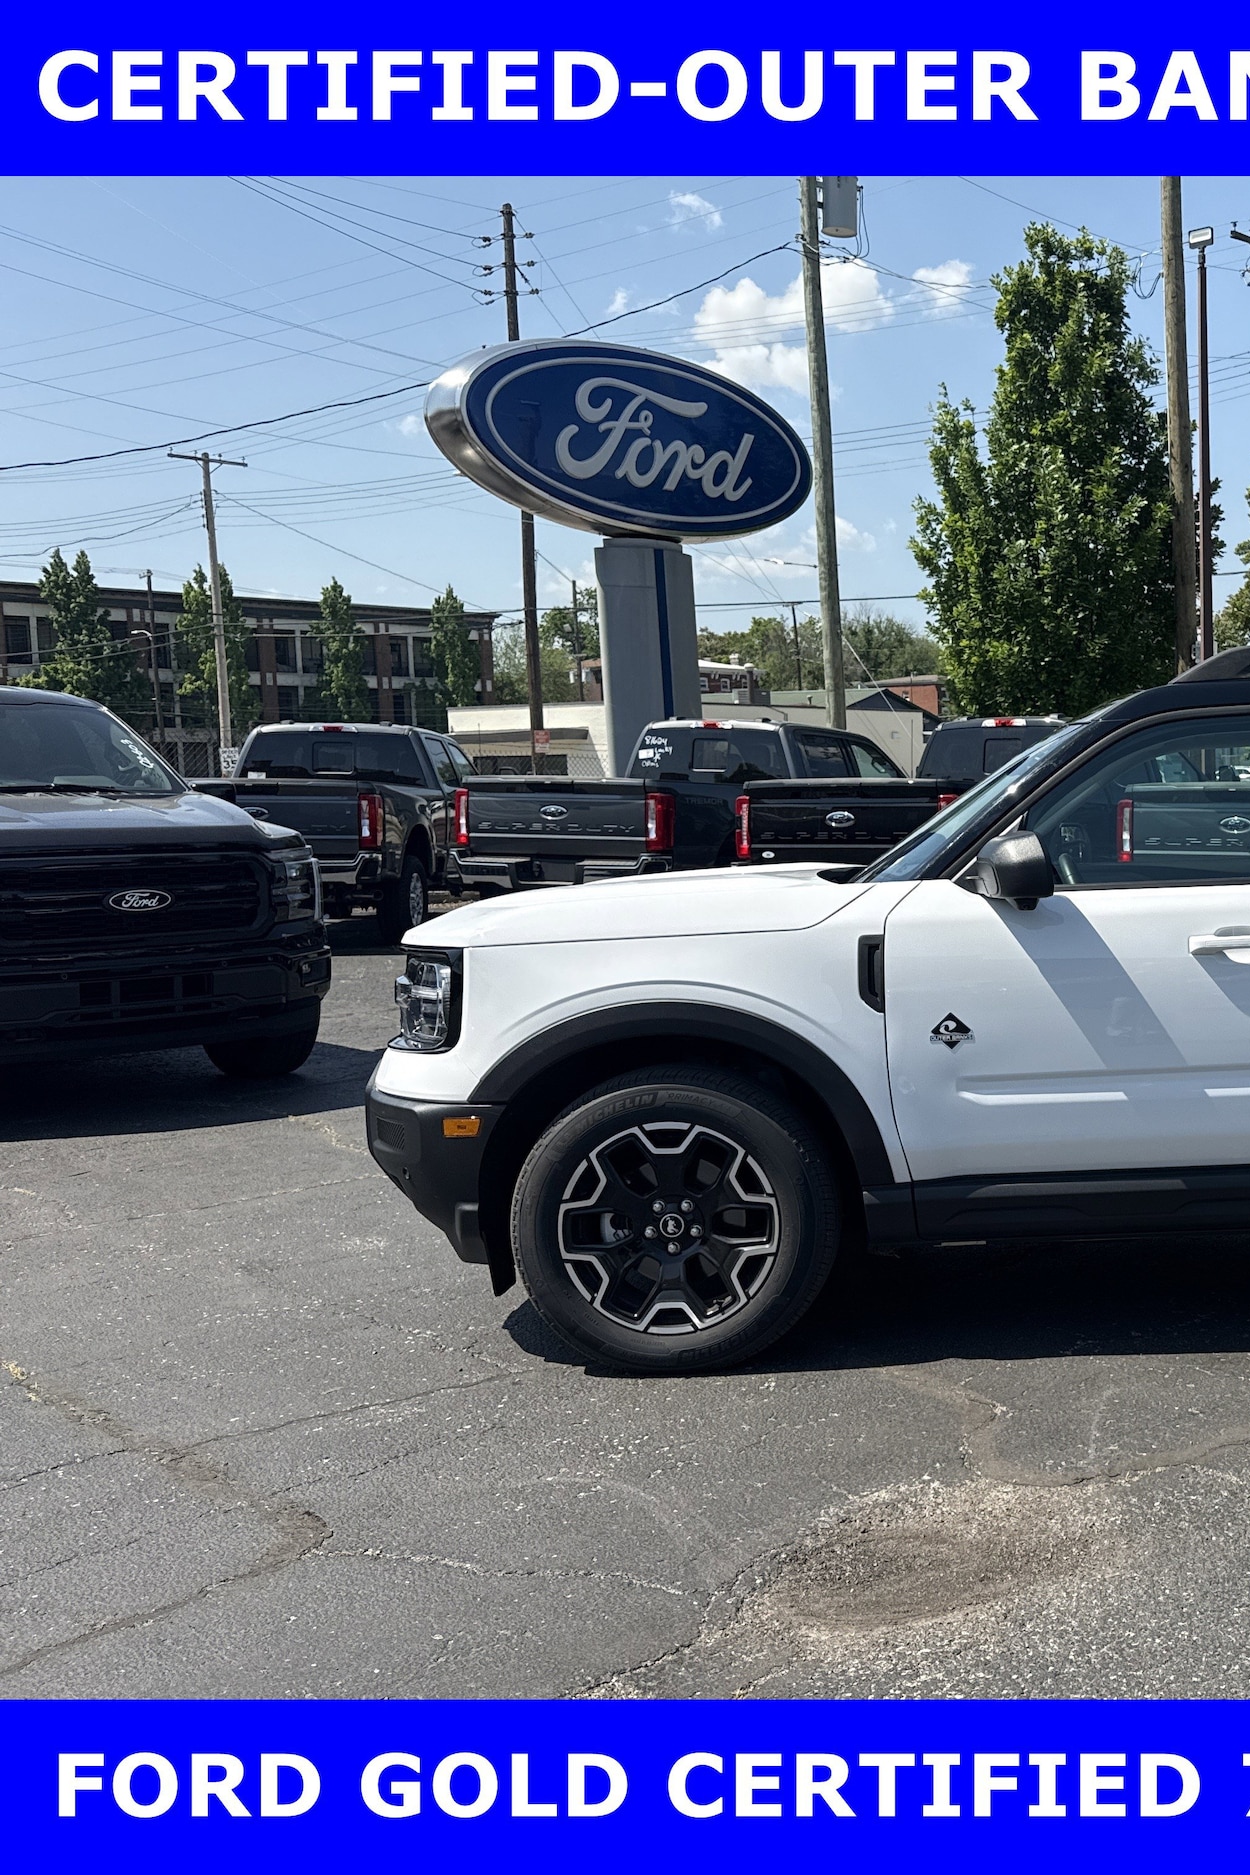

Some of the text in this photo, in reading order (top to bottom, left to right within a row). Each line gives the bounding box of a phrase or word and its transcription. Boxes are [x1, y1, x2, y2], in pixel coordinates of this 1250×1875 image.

[555, 377, 755, 501] Ford
[223, 760, 238, 769] 35
[478, 821, 635, 833] SUPER DUTY
[121, 892, 160, 908] Ford
